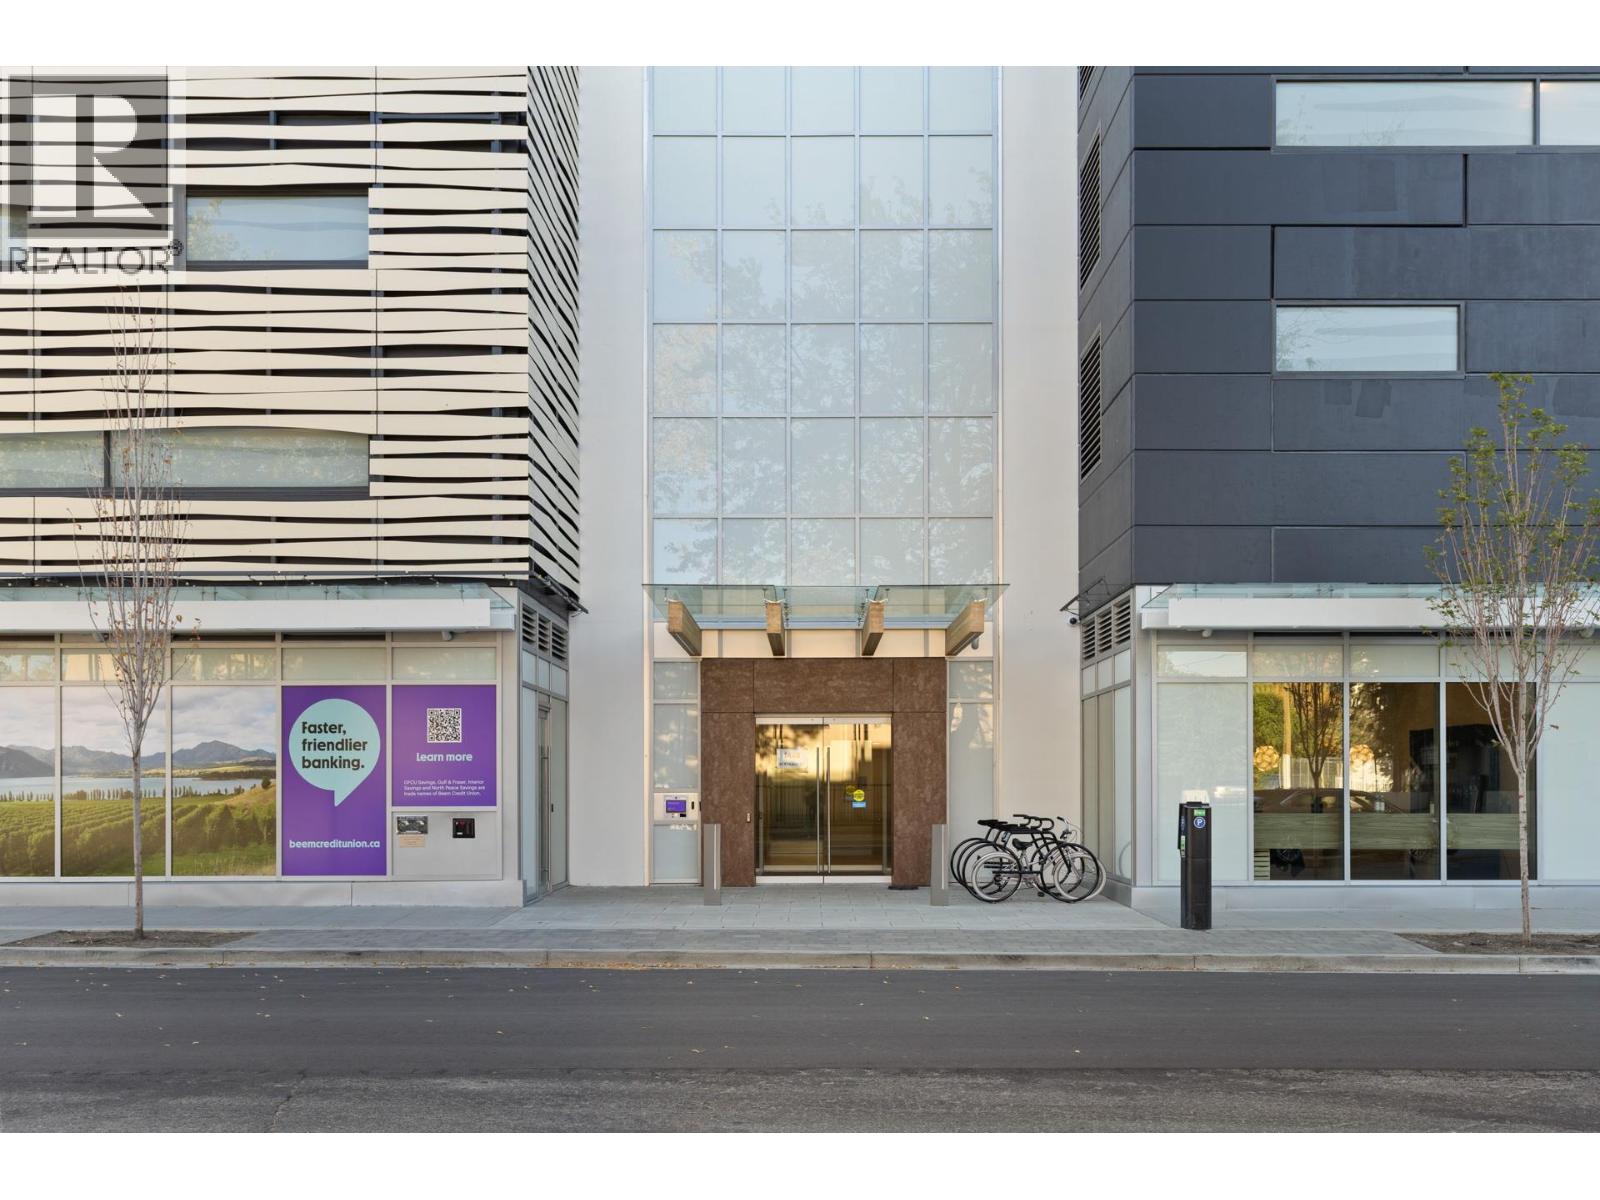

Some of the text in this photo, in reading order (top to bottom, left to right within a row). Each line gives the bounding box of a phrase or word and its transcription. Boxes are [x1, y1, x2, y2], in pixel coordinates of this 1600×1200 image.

[301, 721, 347, 736] Faster,
[301, 738, 368, 752] friendlier
[301, 756, 365, 771] banking.
[416, 752, 473, 761] Learn more
[289, 839, 381, 849] beemcreditunion.ca
